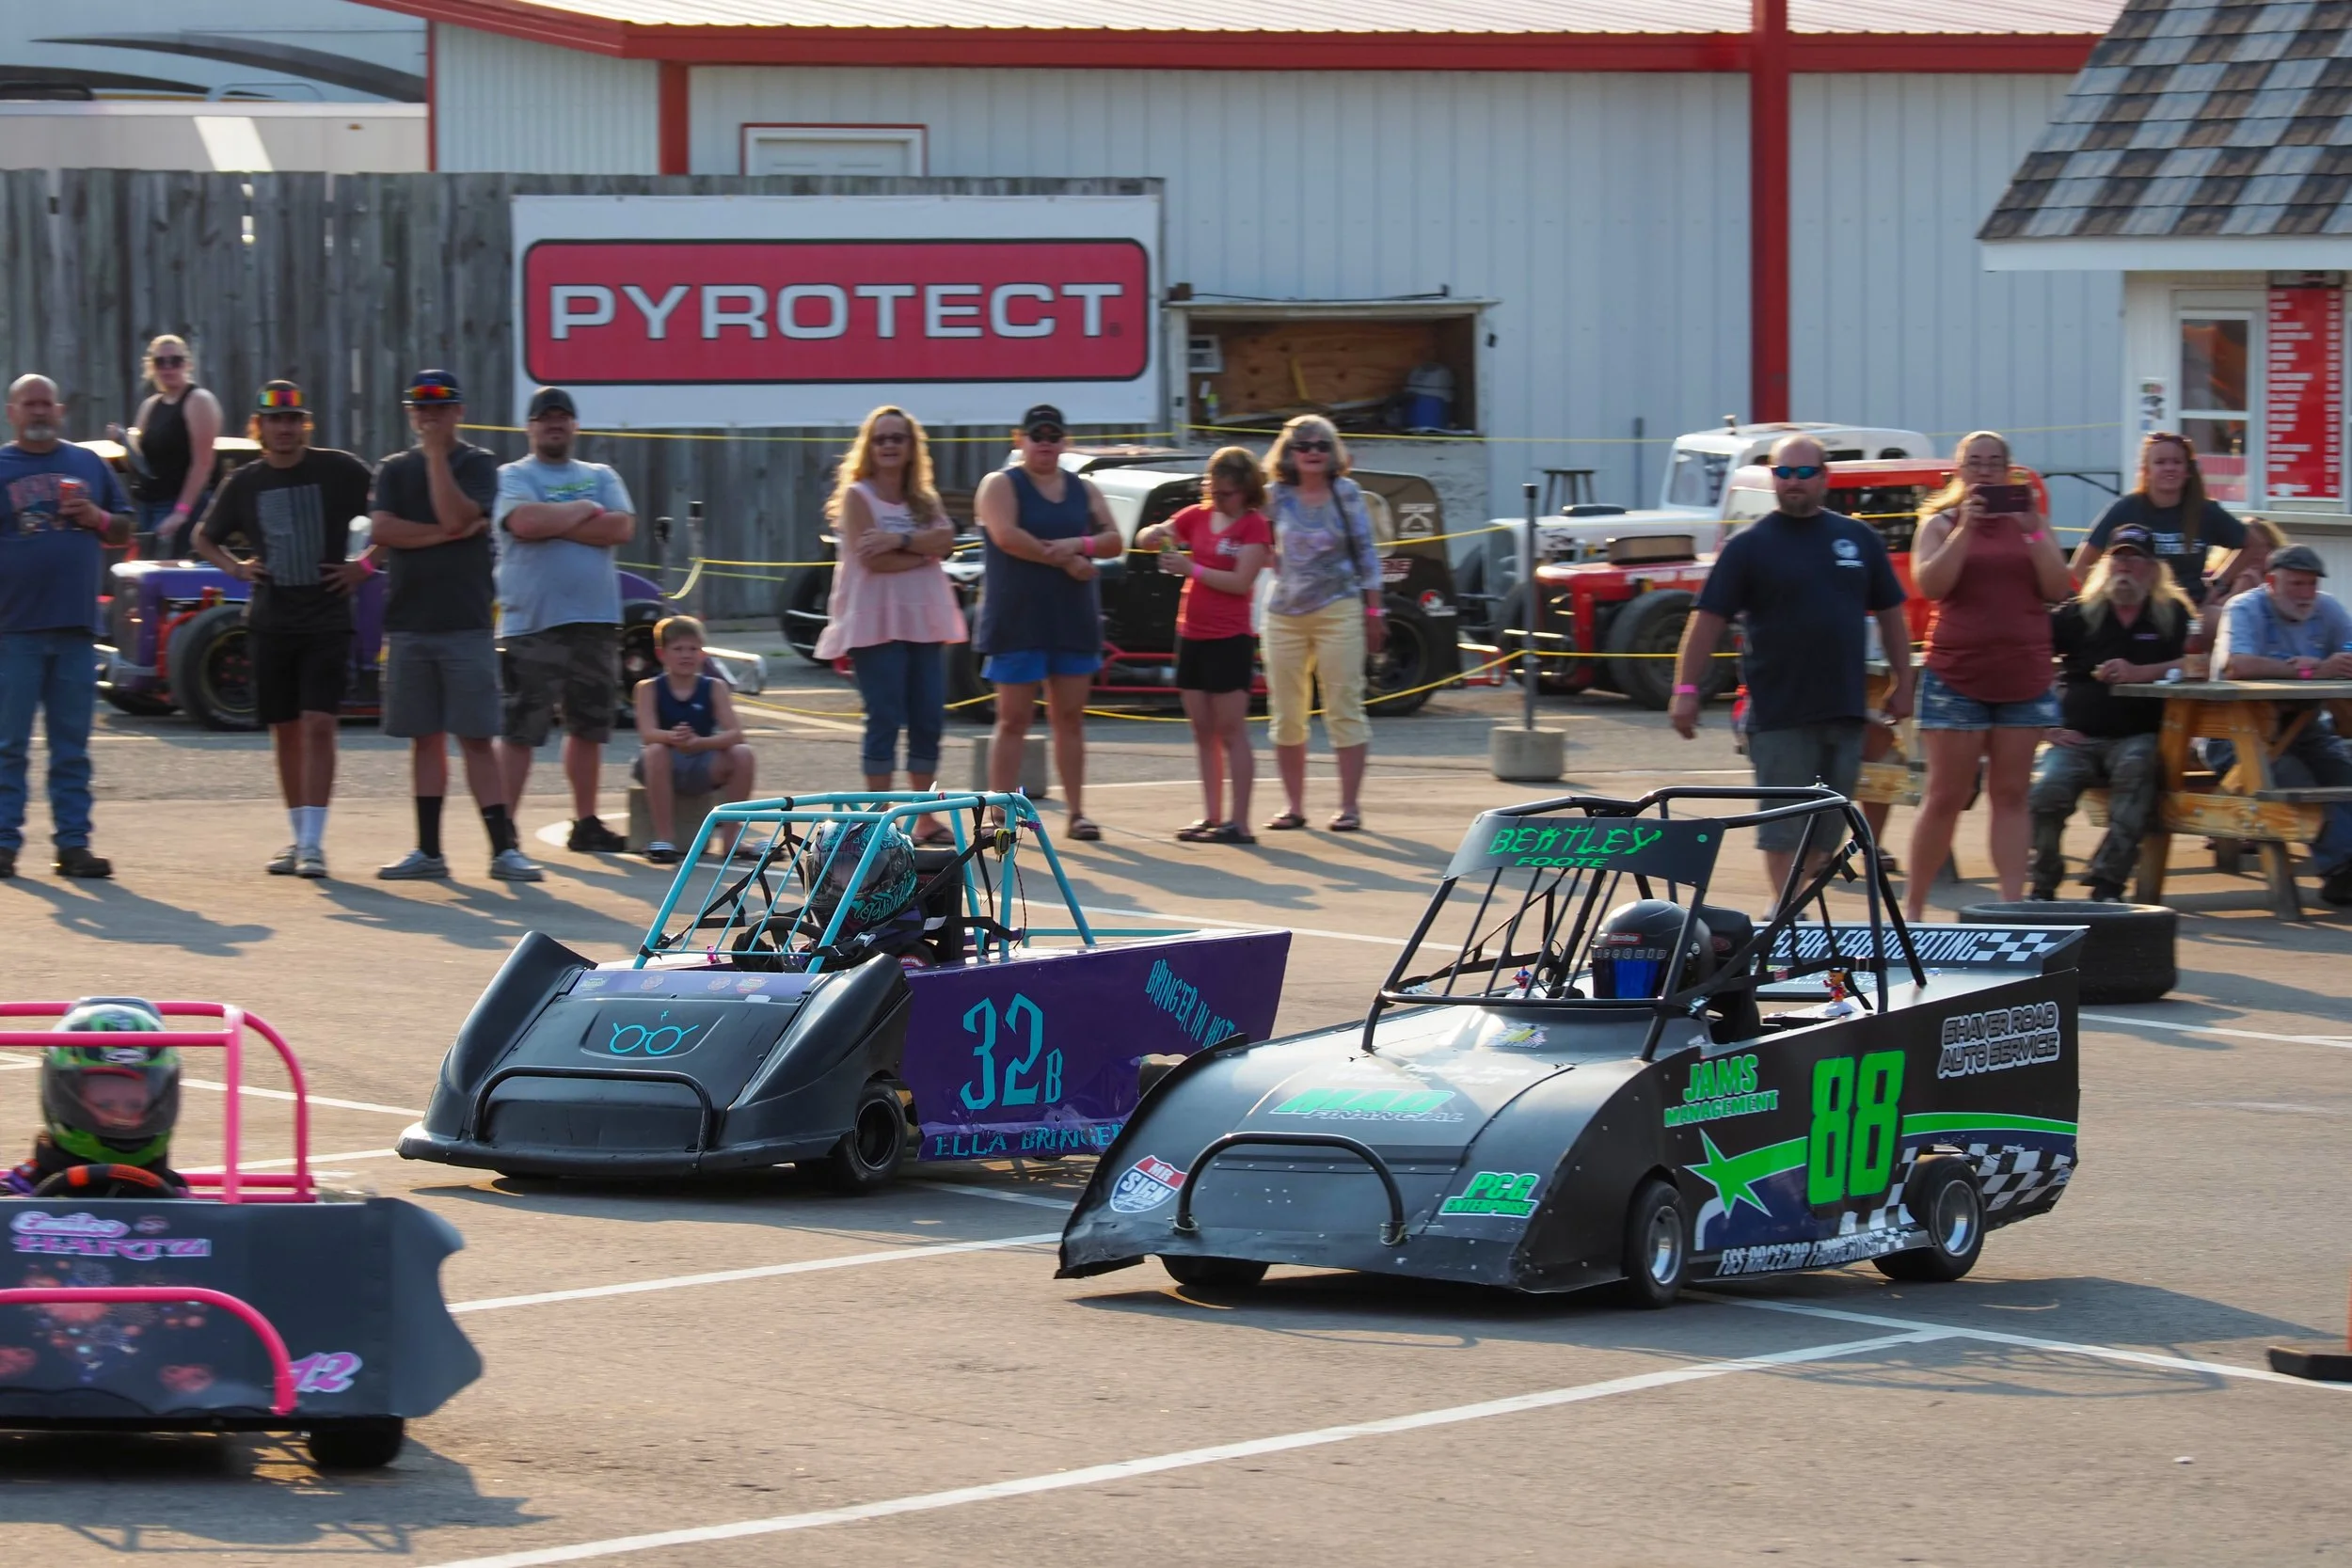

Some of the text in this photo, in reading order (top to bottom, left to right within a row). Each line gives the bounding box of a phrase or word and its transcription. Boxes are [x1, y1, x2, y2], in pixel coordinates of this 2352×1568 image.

[549, 282, 1124, 341] PYROTECT
[1486, 824, 1663, 856] BENTLEY
[1514, 856, 1611, 868] FOOTE
[1189, 1000, 1211, 1043] IN
[1942, 1001, 2058, 1047] SHAVER ROAD
[1937, 1030, 2060, 1079] AUTO SERVICE
[1682, 1053, 1759, 1103] JAMS
[1273, 1087, 1456, 1114] MAD
[1304, 1109, 1465, 1123] FINANCIAL
[1663, 1089, 1779, 1128] MANAGEMENT
[1806, 1049, 1906, 1206] 88
[934, 1131, 1008, 1157] ELLA
[1120, 1171, 1172, 1203] SIGN
[1147, 1162, 1175, 1182] MR
[1465, 1172, 1539, 1200] PCG
